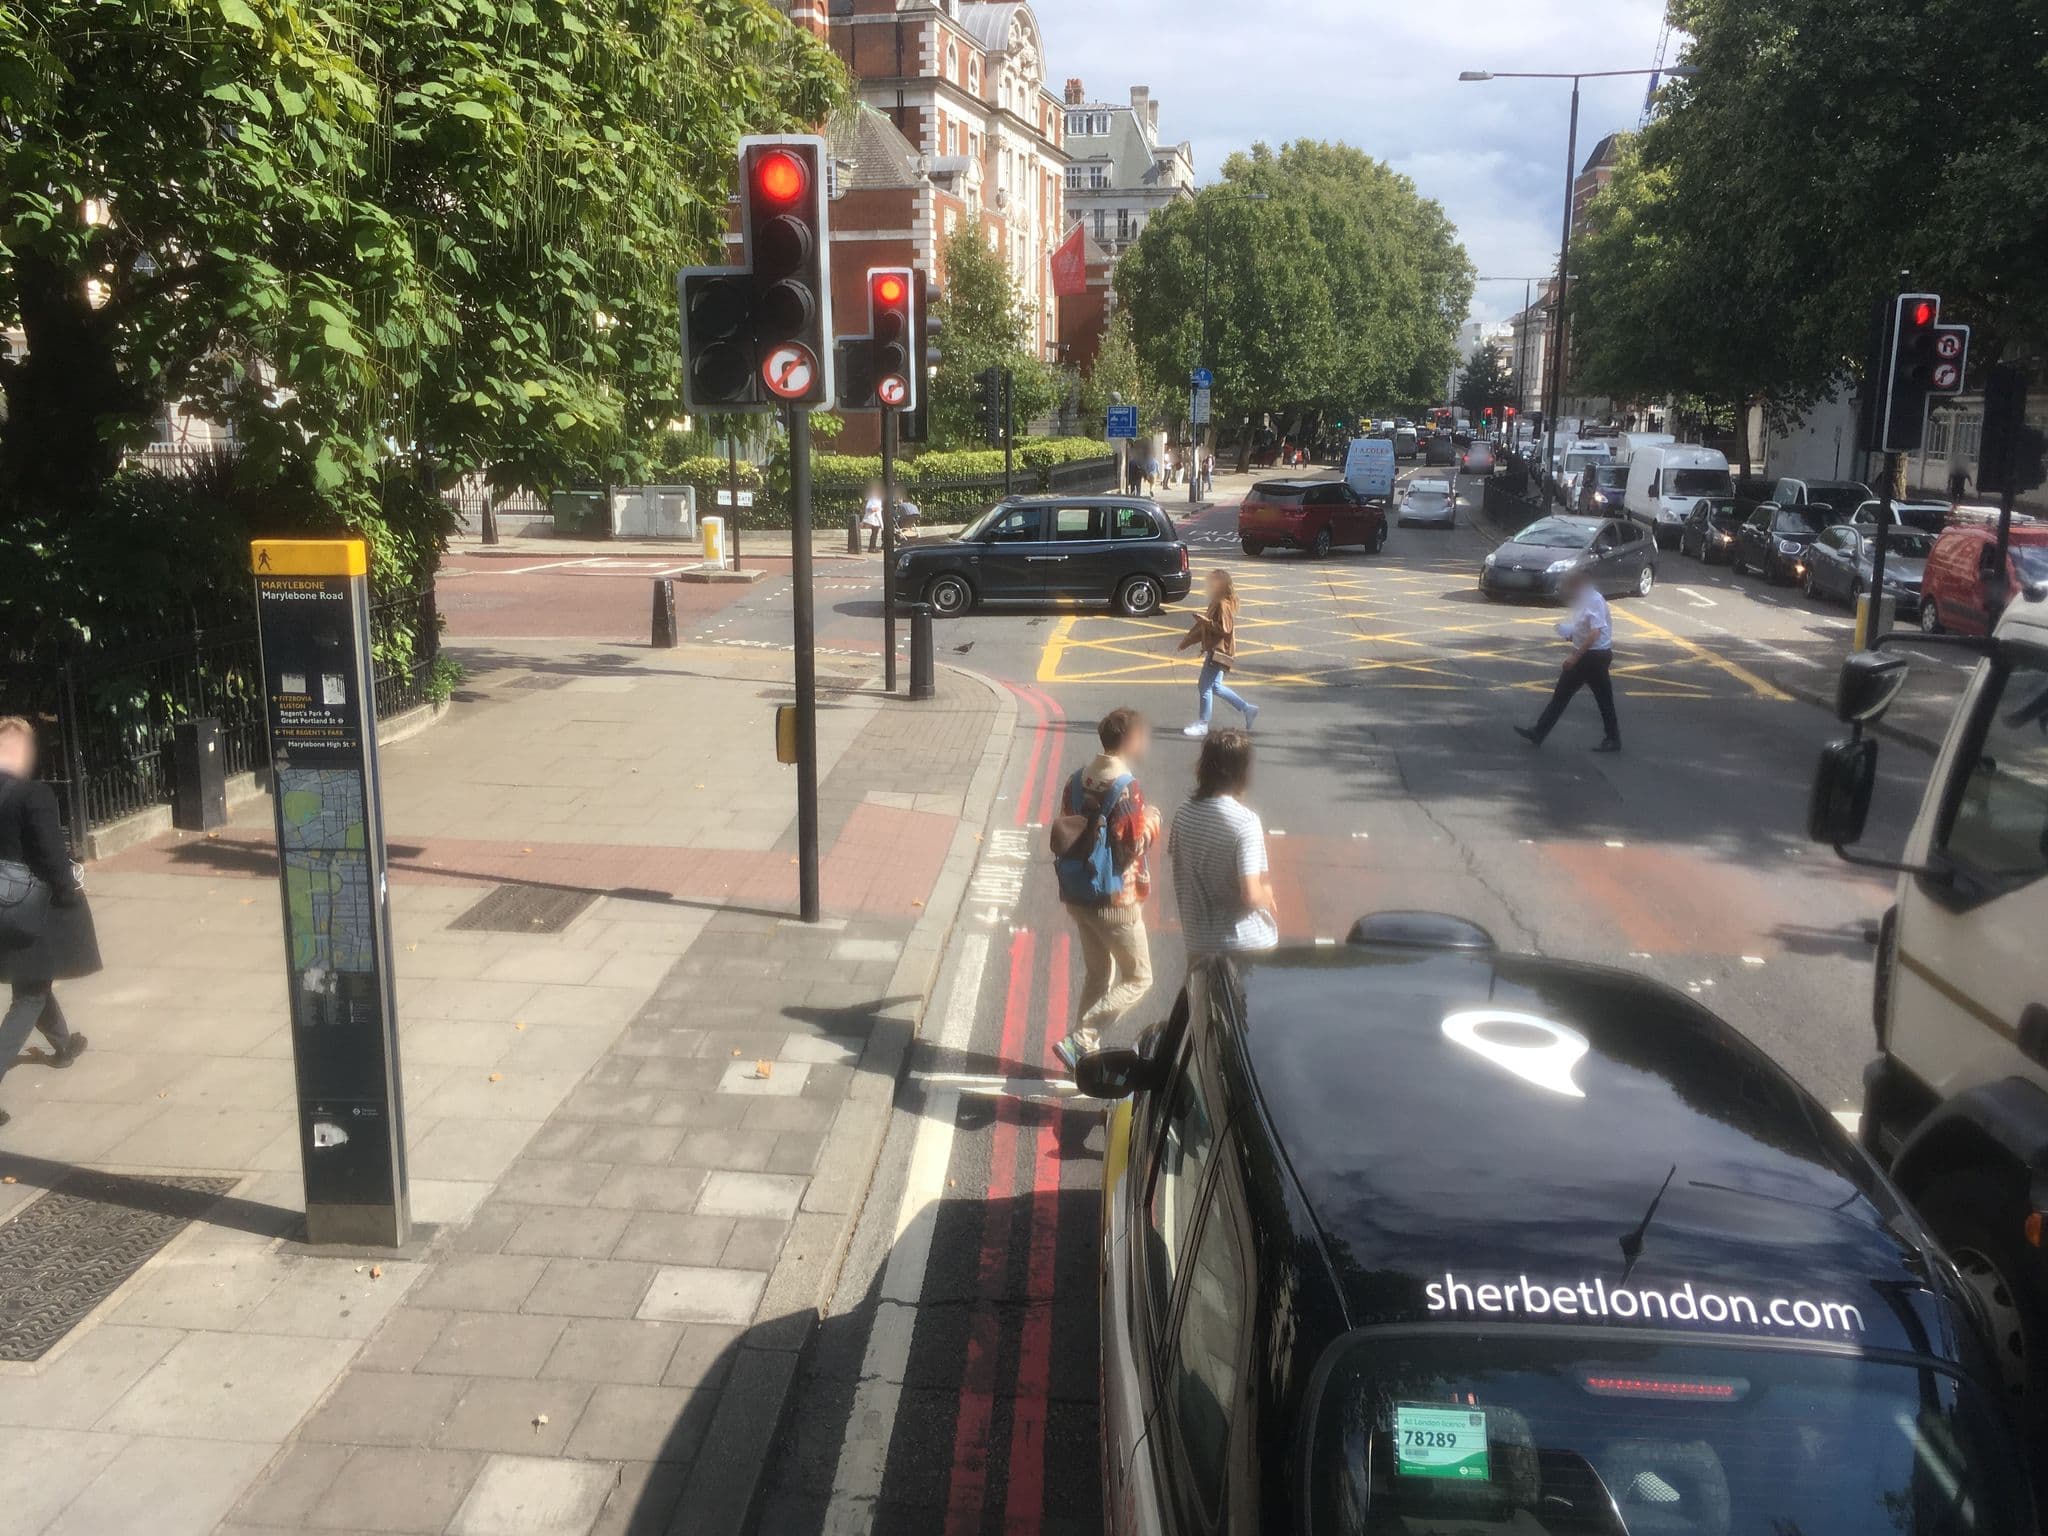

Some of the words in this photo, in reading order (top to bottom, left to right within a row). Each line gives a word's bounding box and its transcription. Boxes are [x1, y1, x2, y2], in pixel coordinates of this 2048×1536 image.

[261, 581, 325, 590] MARYLEBONE
[262, 591, 317, 601] Marylebone
[319, 592, 344, 600] Road
[1426, 1273, 1865, 1332] sherbetlondon.com
[1404, 1430, 1457, 1448] 78289
